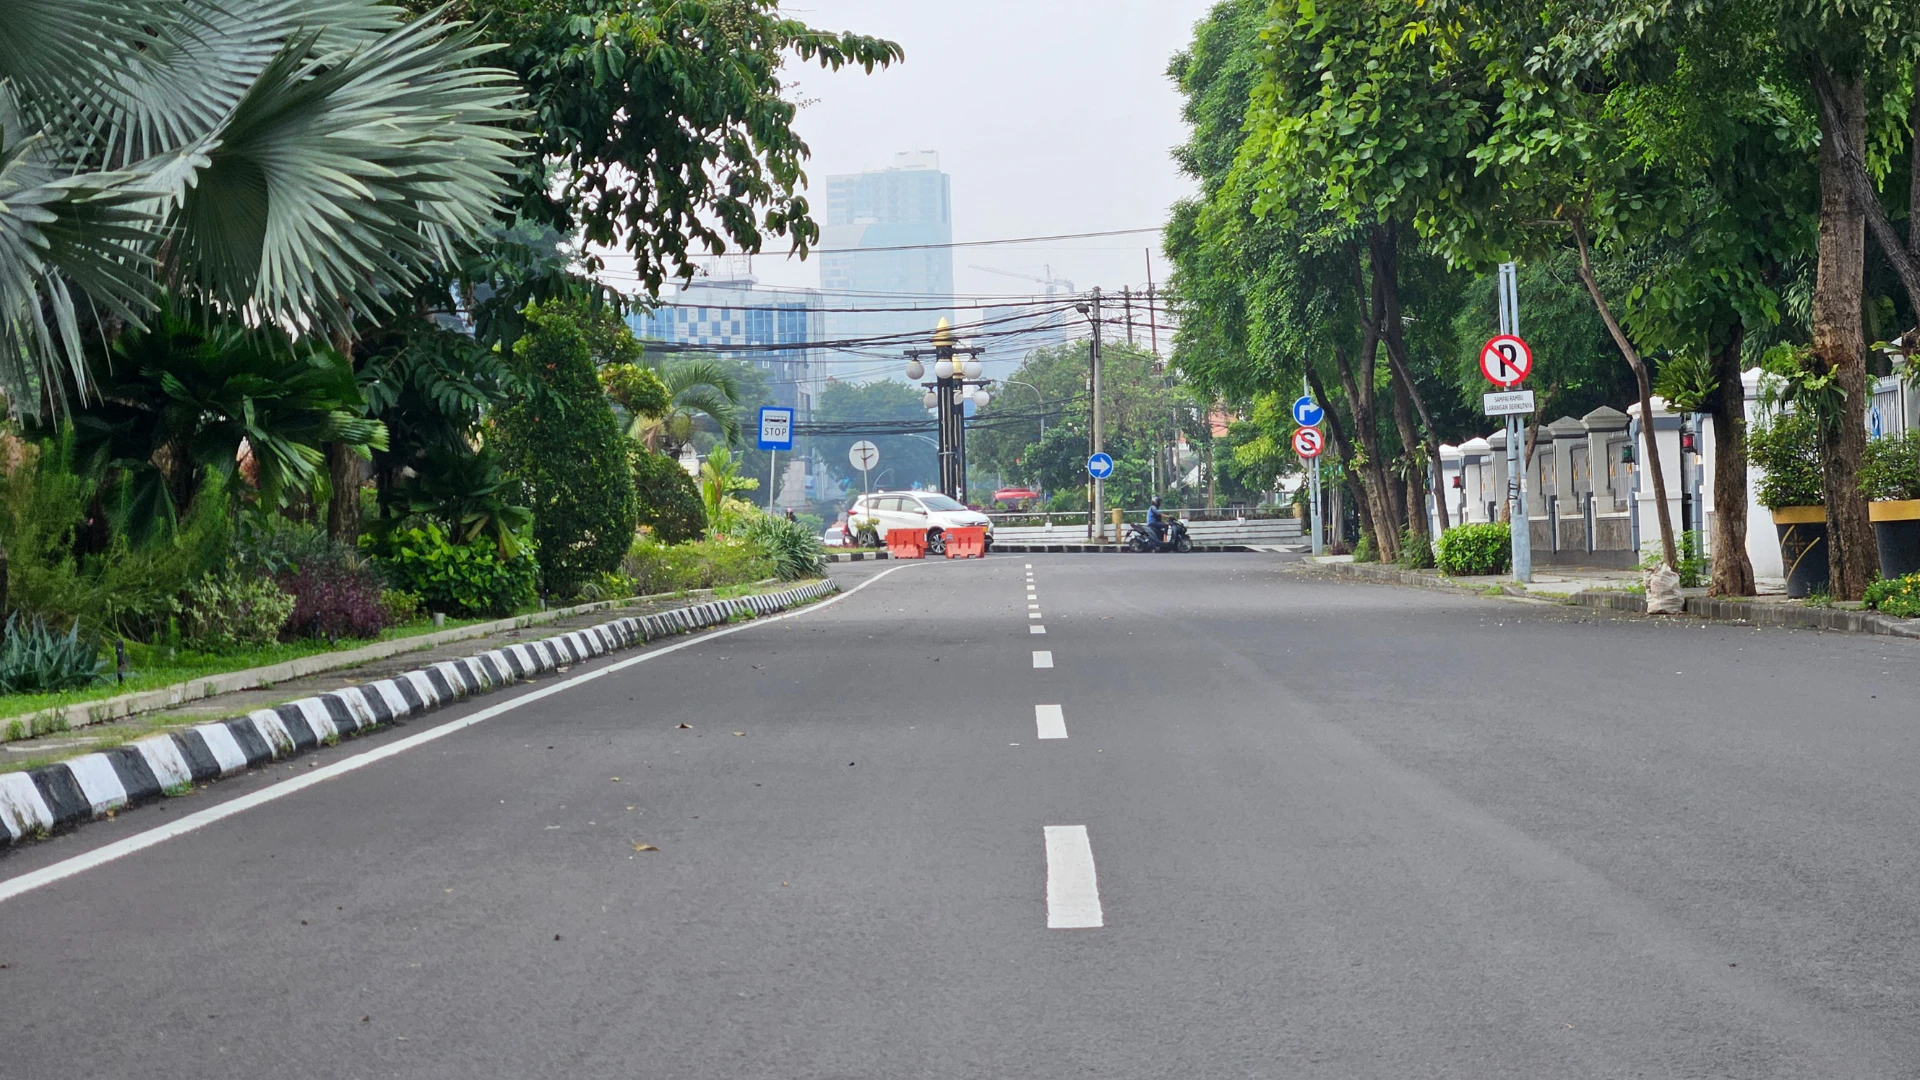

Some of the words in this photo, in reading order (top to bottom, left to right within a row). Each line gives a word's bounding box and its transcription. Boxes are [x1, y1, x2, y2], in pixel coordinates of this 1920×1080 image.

[1498, 344, 1517, 377] P
[1494, 395, 1509, 403] SAMPAI
[1486, 403, 1508, 412] LARANGAN
[1508, 402, 1533, 410] BERIKUTNYA
[764, 427, 787, 436] STOP
[1300, 432, 1316, 451] S
